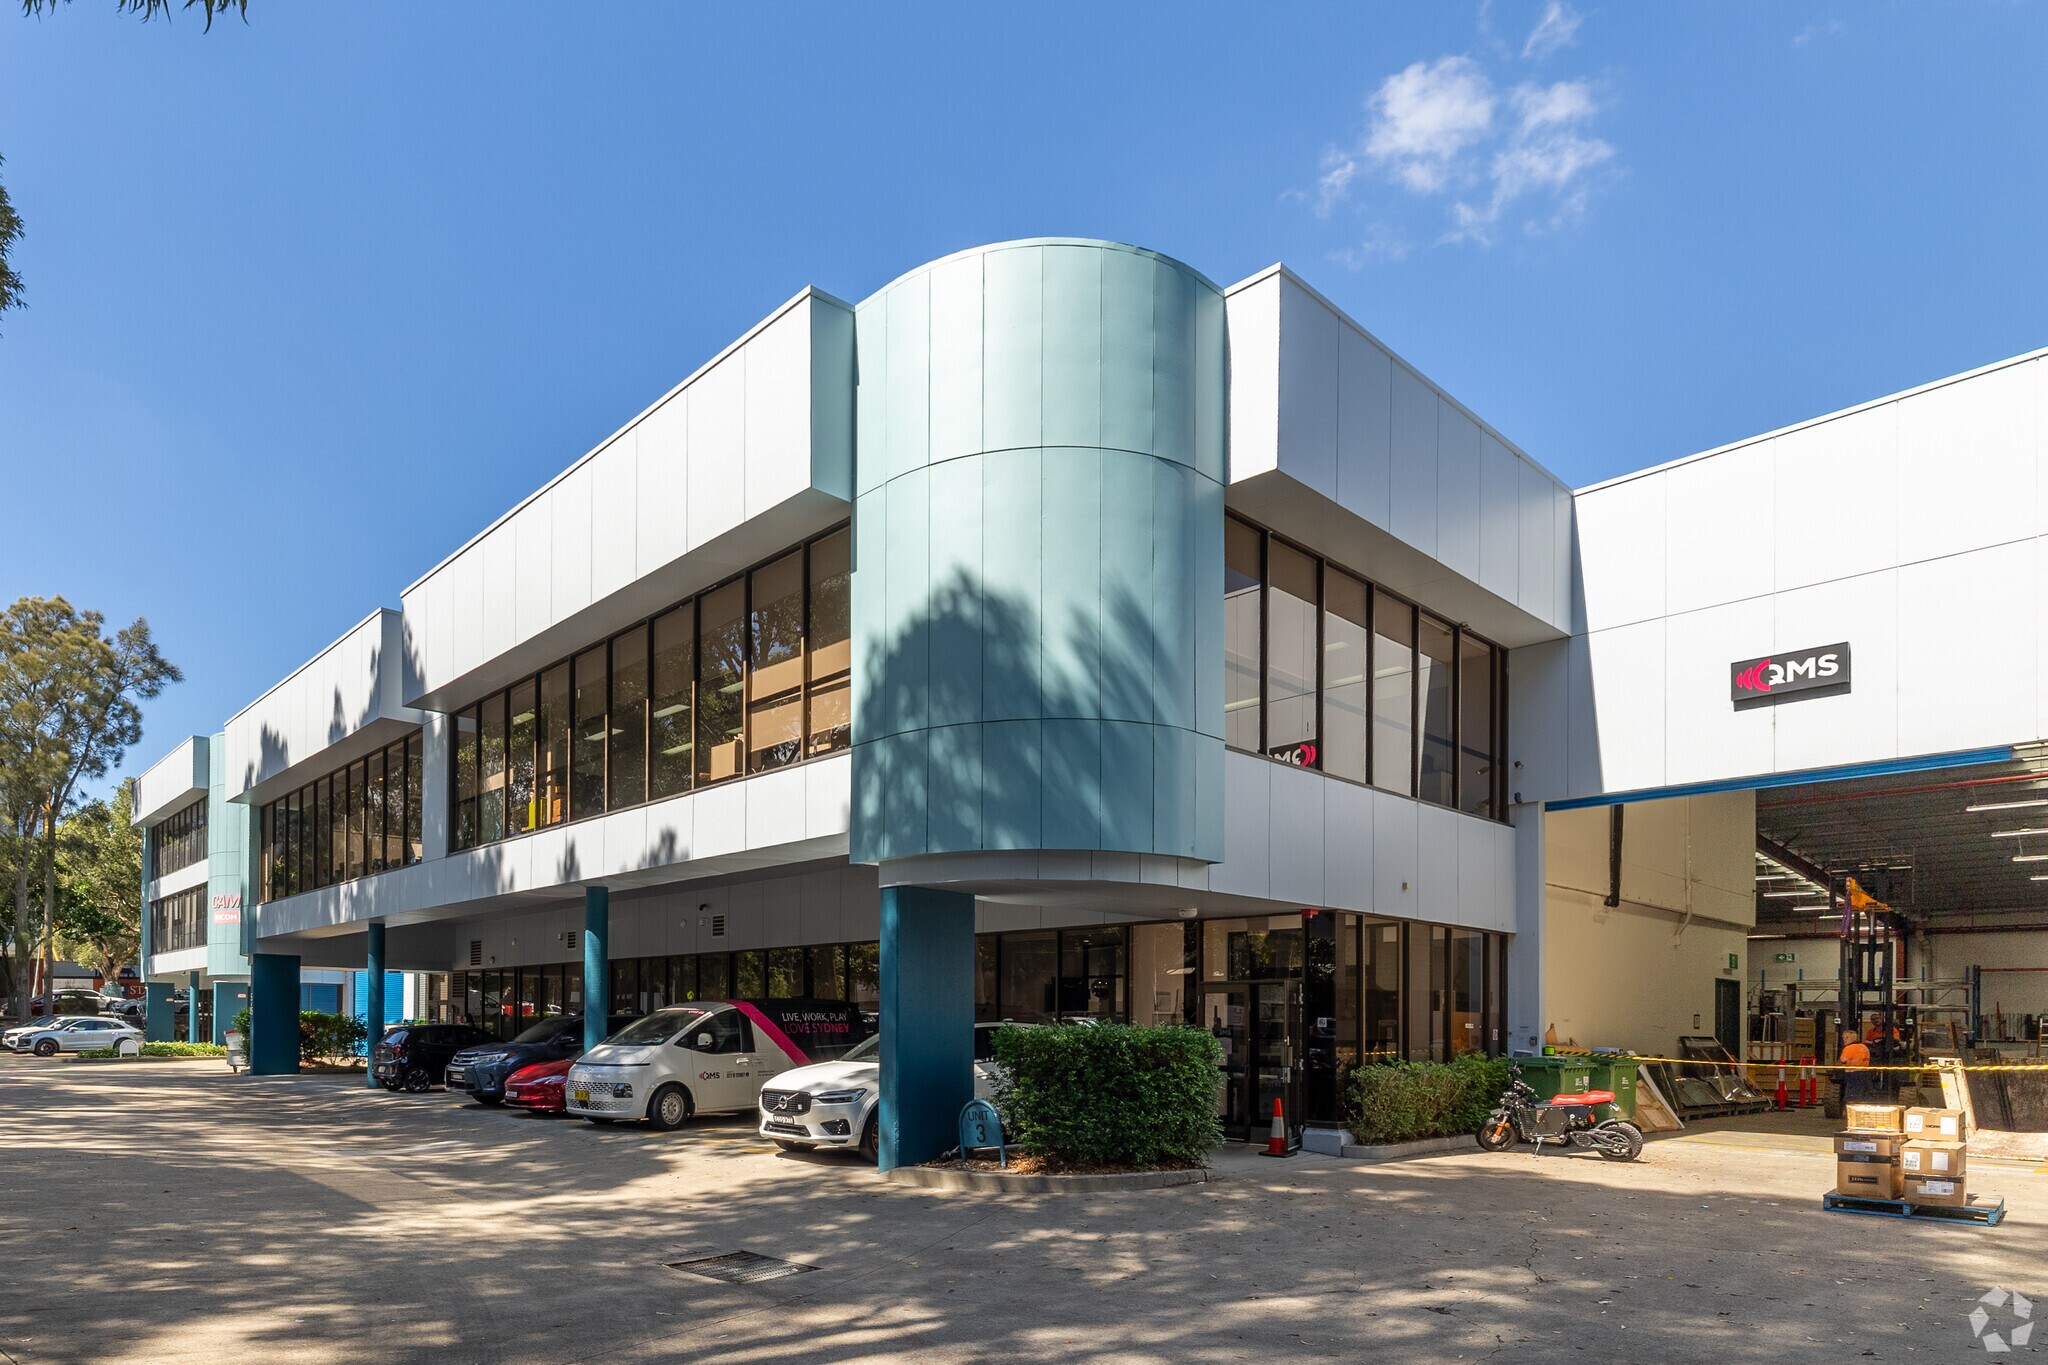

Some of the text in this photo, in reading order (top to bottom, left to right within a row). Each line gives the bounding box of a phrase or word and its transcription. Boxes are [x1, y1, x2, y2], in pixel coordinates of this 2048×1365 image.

[1750, 653, 1839, 692] QMS
[781, 1012, 848, 1023] LIVE, WORK, PLAY
[784, 1022, 849, 1034] LOVE SYDNEY
[701, 1070, 720, 1081] QMS
[967, 1110, 990, 1121] UNIT
[975, 1123, 987, 1143] 3
